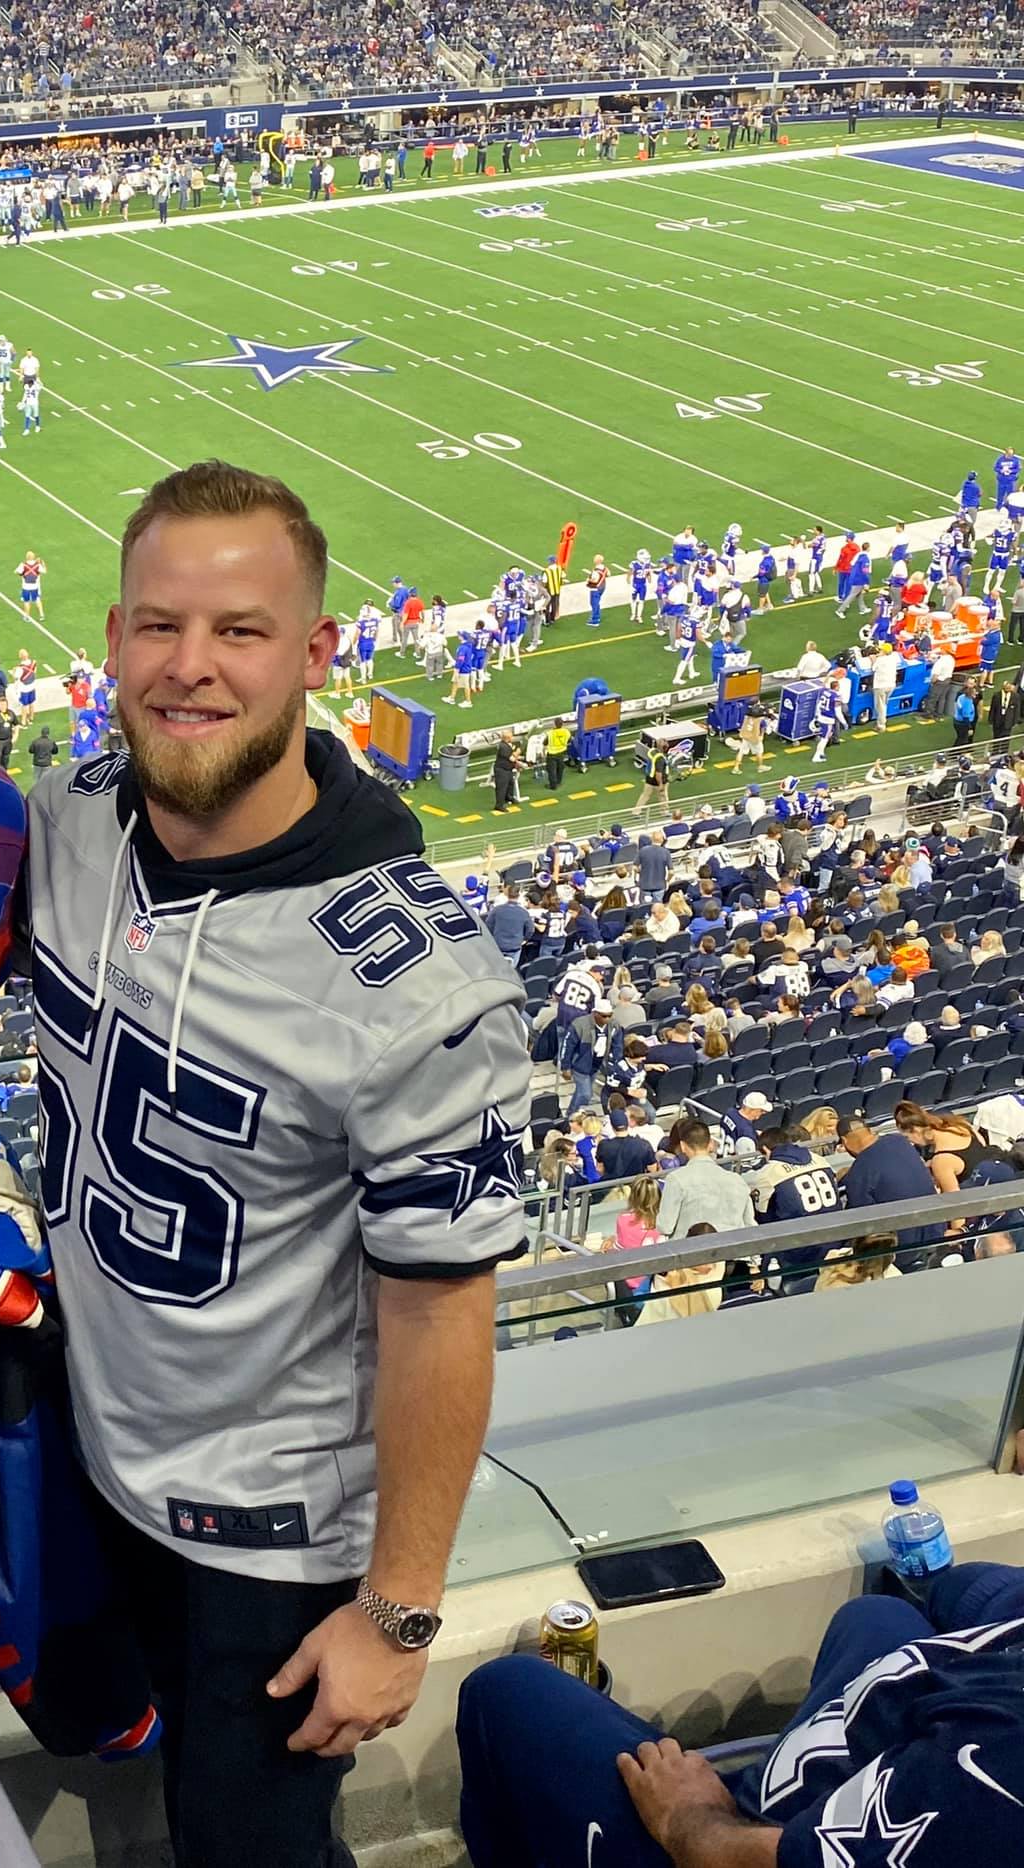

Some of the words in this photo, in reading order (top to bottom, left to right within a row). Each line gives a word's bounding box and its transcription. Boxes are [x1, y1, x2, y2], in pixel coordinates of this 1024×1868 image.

[886, 362, 984, 387] 30
[675, 395, 763, 421] 40
[416, 432, 523, 460] 50
[308, 853, 482, 988] 55
[127, 926, 153, 950] NFL
[87, 951, 154, 1010] CWBOYS
[563, 979, 593, 1012] 82
[793, 1169, 837, 1213] 88
[231, 1513, 260, 1530] XL
